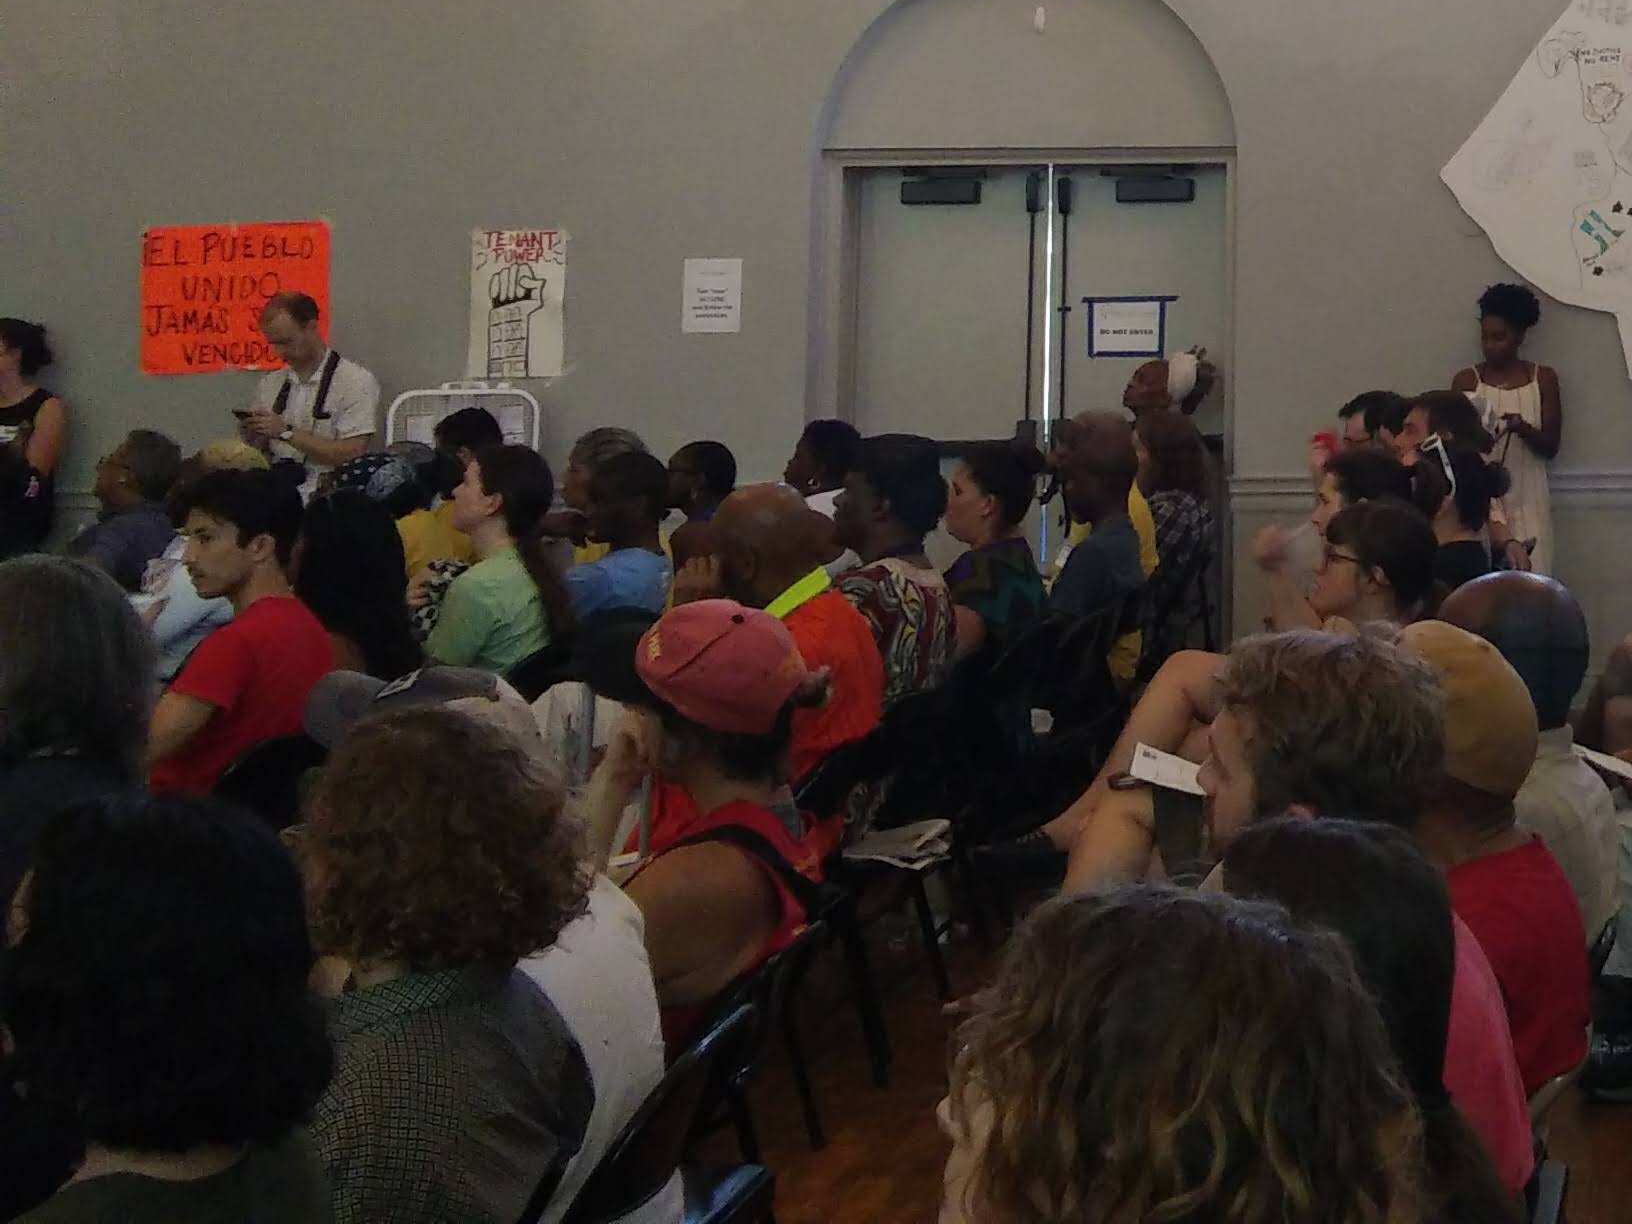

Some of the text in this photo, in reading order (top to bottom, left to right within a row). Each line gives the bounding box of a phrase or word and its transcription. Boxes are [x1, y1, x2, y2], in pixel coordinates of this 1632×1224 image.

[143, 232, 314, 267] EL PUEBLO
[483, 231, 558, 251] TENANT
[181, 272, 279, 301] UNIDO
